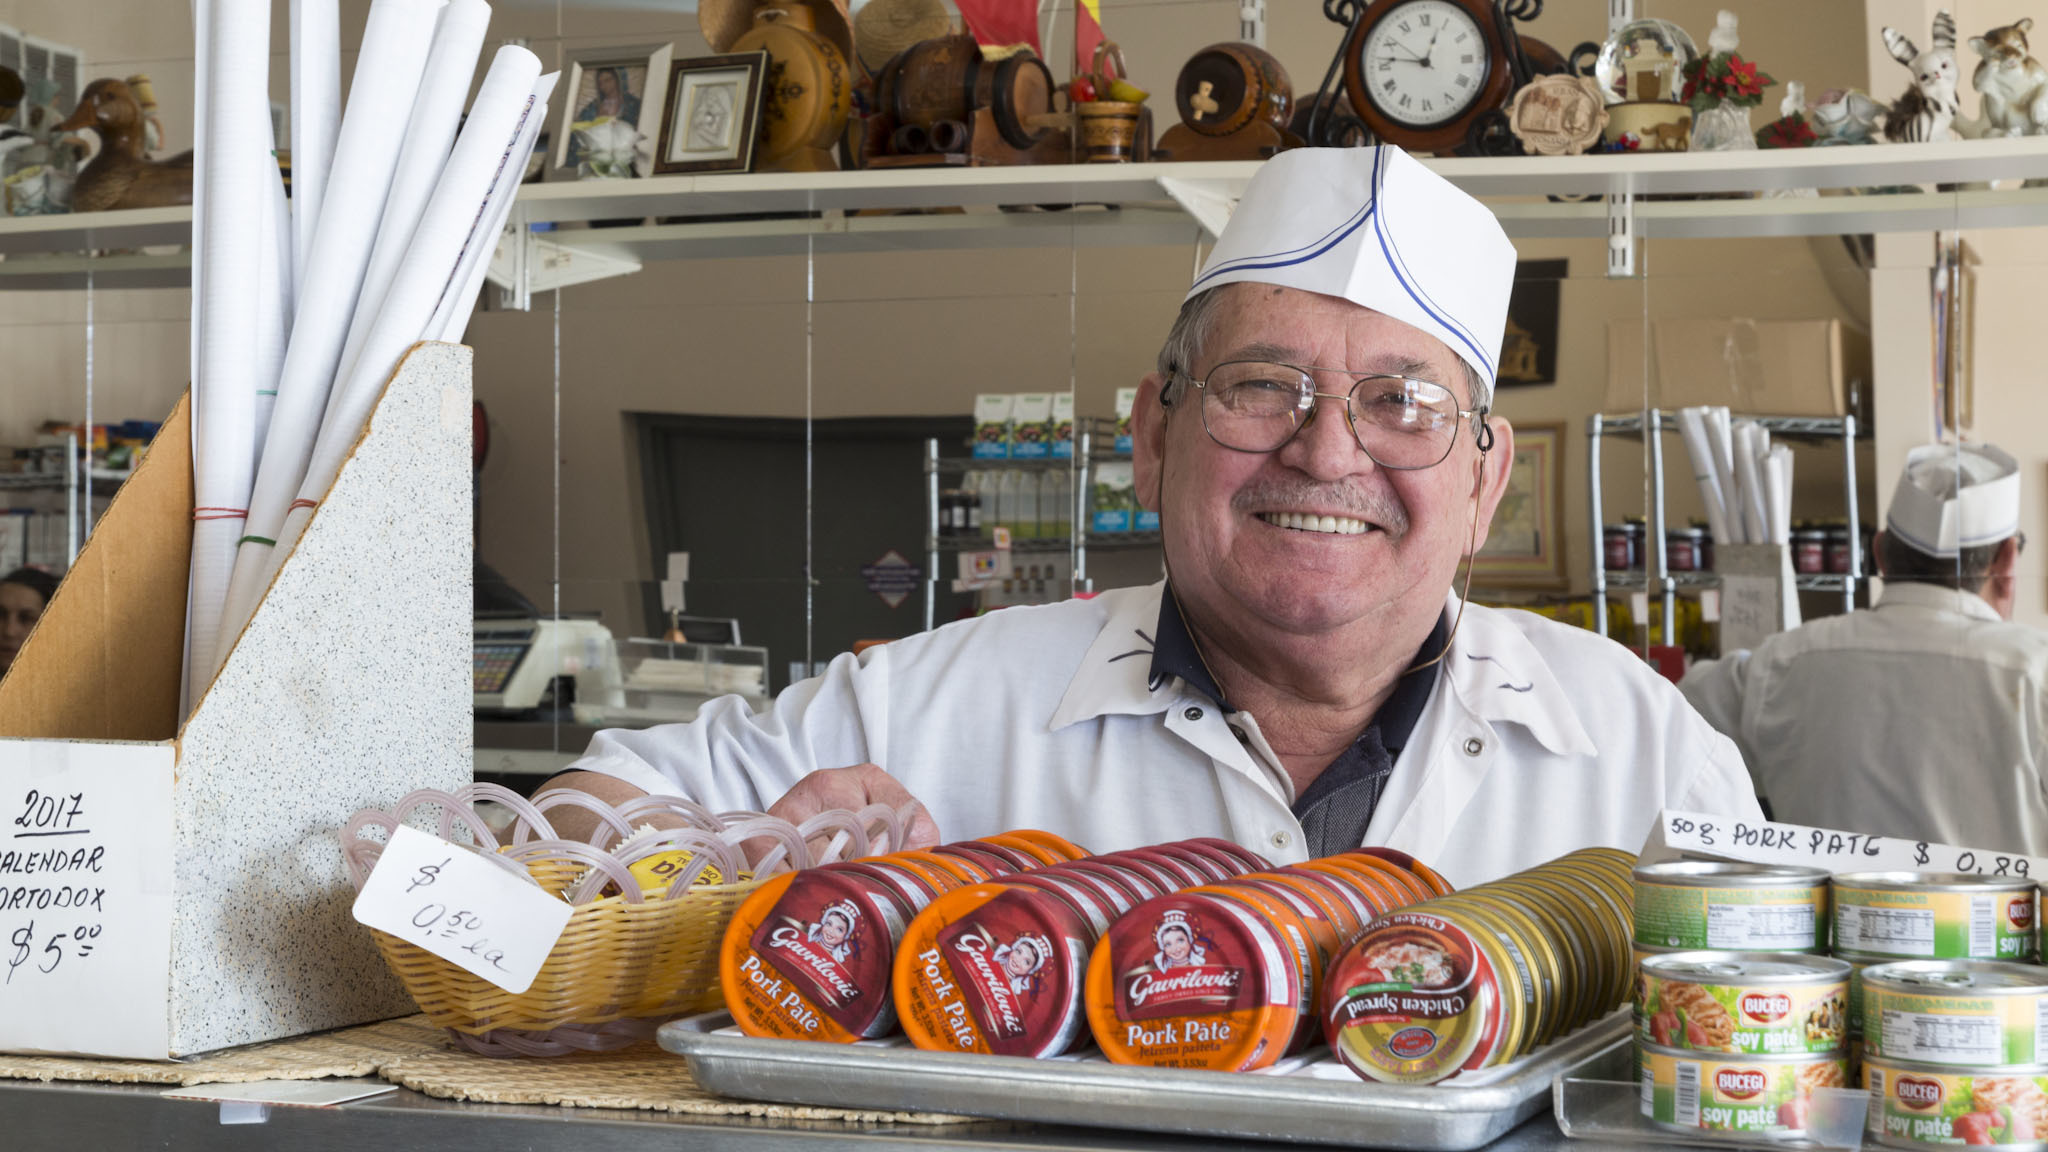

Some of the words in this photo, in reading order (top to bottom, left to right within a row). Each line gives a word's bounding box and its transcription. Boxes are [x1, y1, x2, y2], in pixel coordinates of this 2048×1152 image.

[14, 789, 83, 828] 2017
[1733, 823, 1797, 849] PORK
[1808, 830, 1881, 855] PATE
[0, 846, 104, 873] ALENDAR
[1395, 915, 1446, 931] Chicken
[2000, 937, 2021, 956] soy
[769, 927, 859, 1000] Gavrilović
[739, 955, 783, 1000] Pork
[779, 991, 820, 1032] Pâté
[955, 934, 1022, 1034] Gavrilović
[1129, 969, 1239, 1006] Gavrilović
[918, 948, 954, 1000] Pork
[944, 1000, 976, 1048] Pâté
[1346, 993, 1398, 1018] Spread
[1402, 996, 1465, 1016] Chicken
[1744, 998, 1789, 1013] BUCEGI
[1127, 1023, 1178, 1046] Pork
[1184, 1020, 1230, 1042] Pâté
[1731, 1032, 1760, 1050] soy
[1763, 1027, 1797, 1050] paté
[1718, 1073, 1764, 1090] BUCEGI
[1899, 1081, 1939, 1100] BUCEGI
[1702, 1107, 1732, 1127] soy
[1737, 1103, 1777, 1127] paté
[1887, 1115, 1910, 1136] soy
[1914, 1116, 1953, 1137] paté
